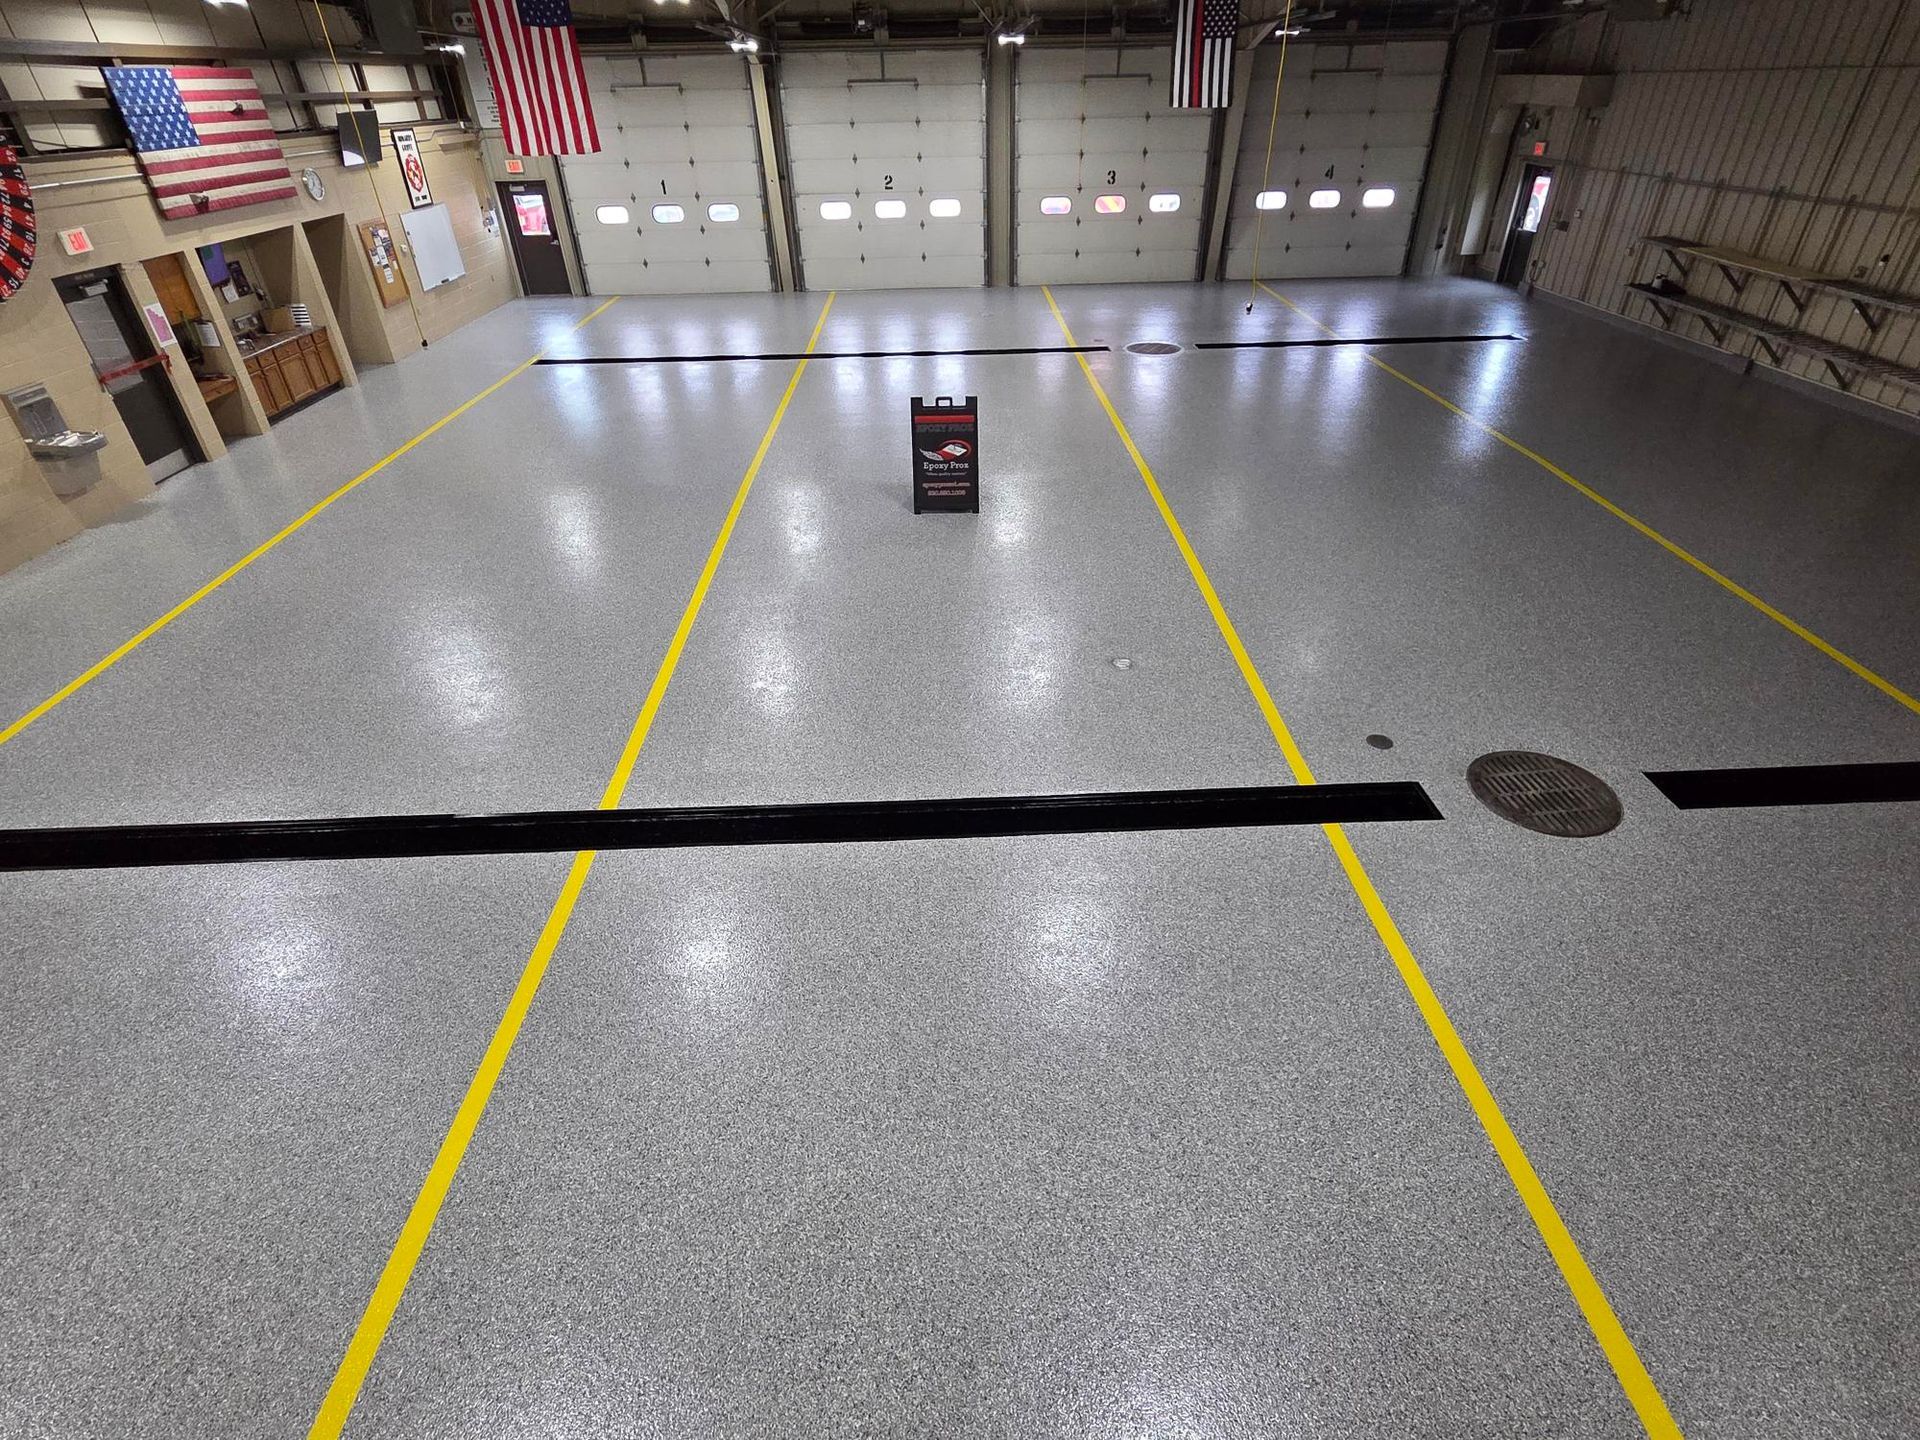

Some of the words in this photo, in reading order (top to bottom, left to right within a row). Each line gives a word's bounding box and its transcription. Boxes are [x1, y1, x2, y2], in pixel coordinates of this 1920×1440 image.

[1107, 170, 1116, 185] 3
[1325, 164, 1335, 180] 4
[660, 179, 667, 195] 1
[884, 174, 894, 190] 2
[923, 461, 949, 471] Epoxy
